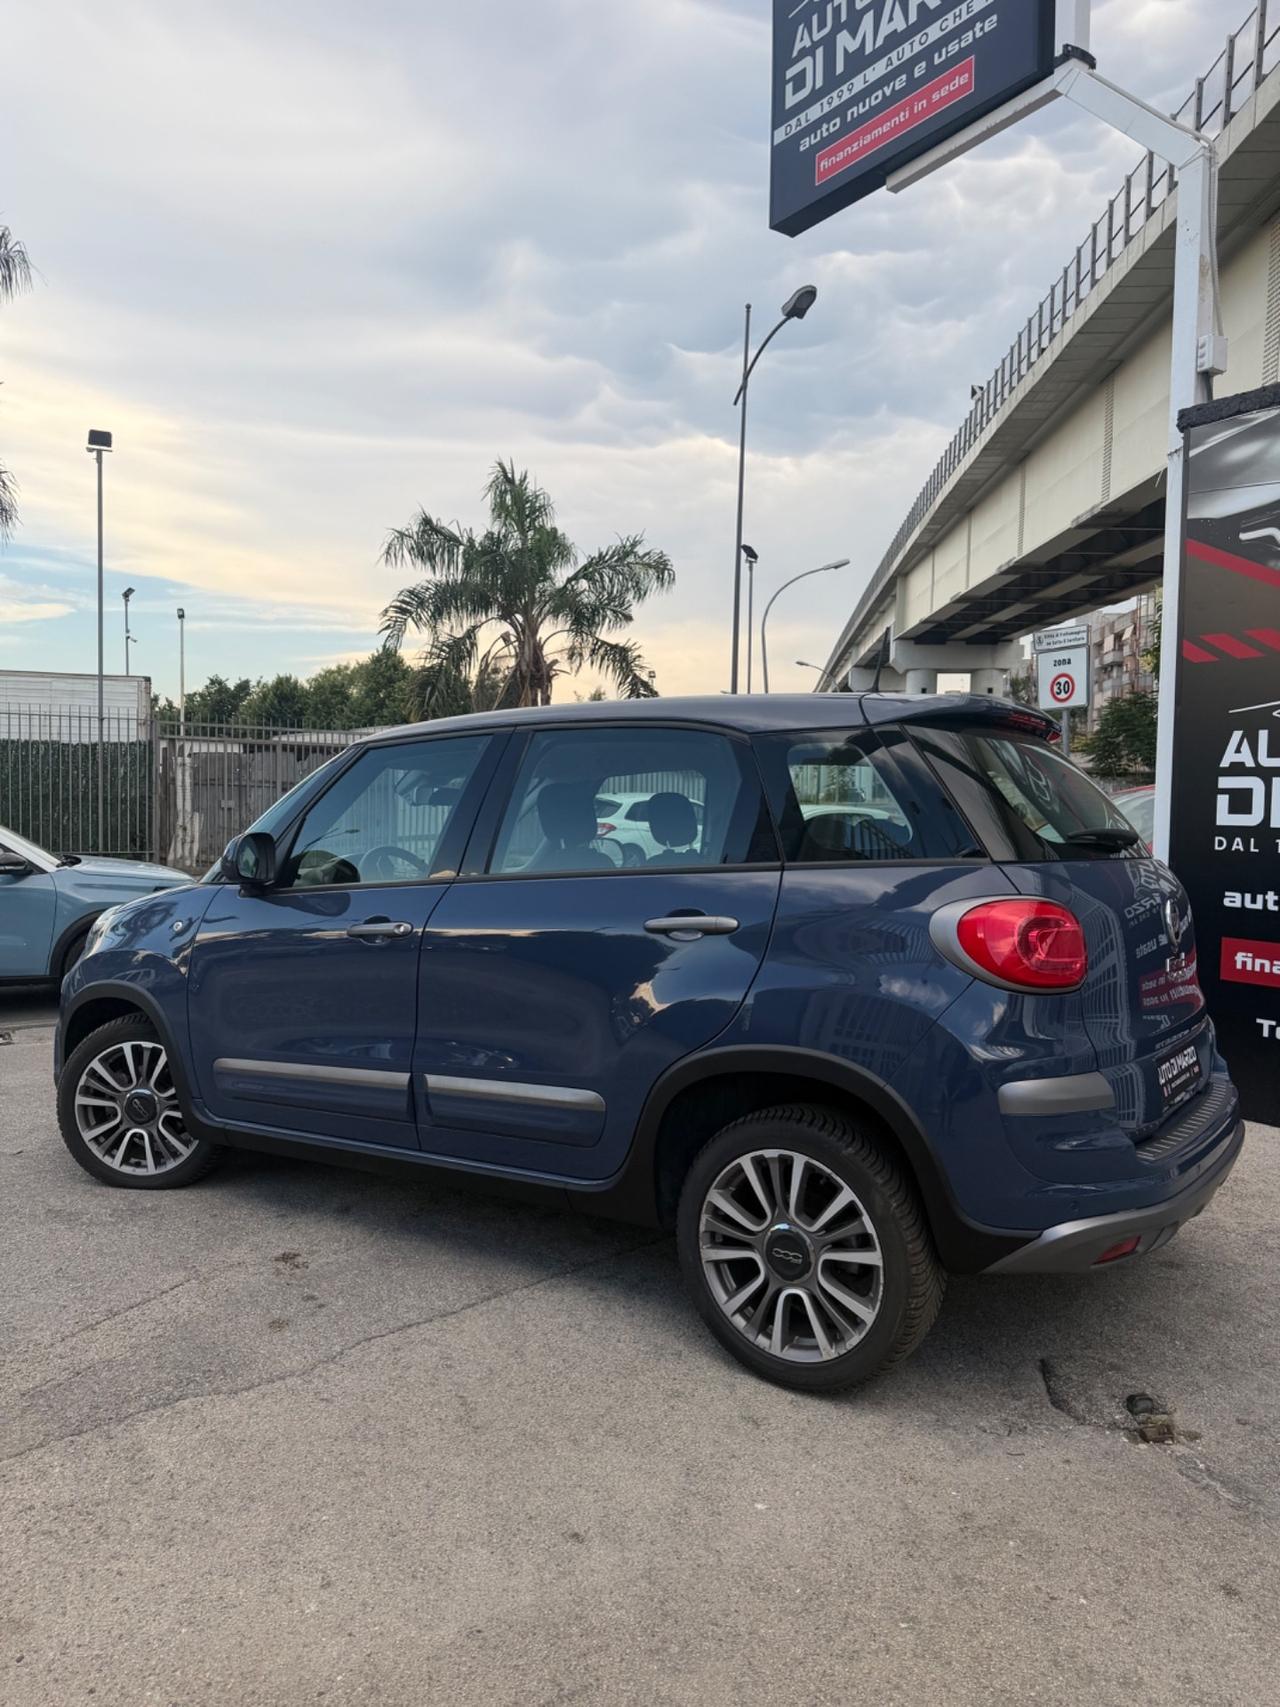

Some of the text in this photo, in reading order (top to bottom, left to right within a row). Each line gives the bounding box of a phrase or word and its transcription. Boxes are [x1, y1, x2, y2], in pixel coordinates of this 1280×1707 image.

[785, 45, 824, 110] DI
[799, 14, 998, 152] auto nuove e usate
[784, 113, 811, 136] DAL
[820, 82, 854, 113] 1999
[820, 73, 969, 172] finanziamenti in sede
[1053, 658, 1072, 667] zona
[1055, 680, 1070, 695] 30
[1214, 836, 1259, 853] DAL
